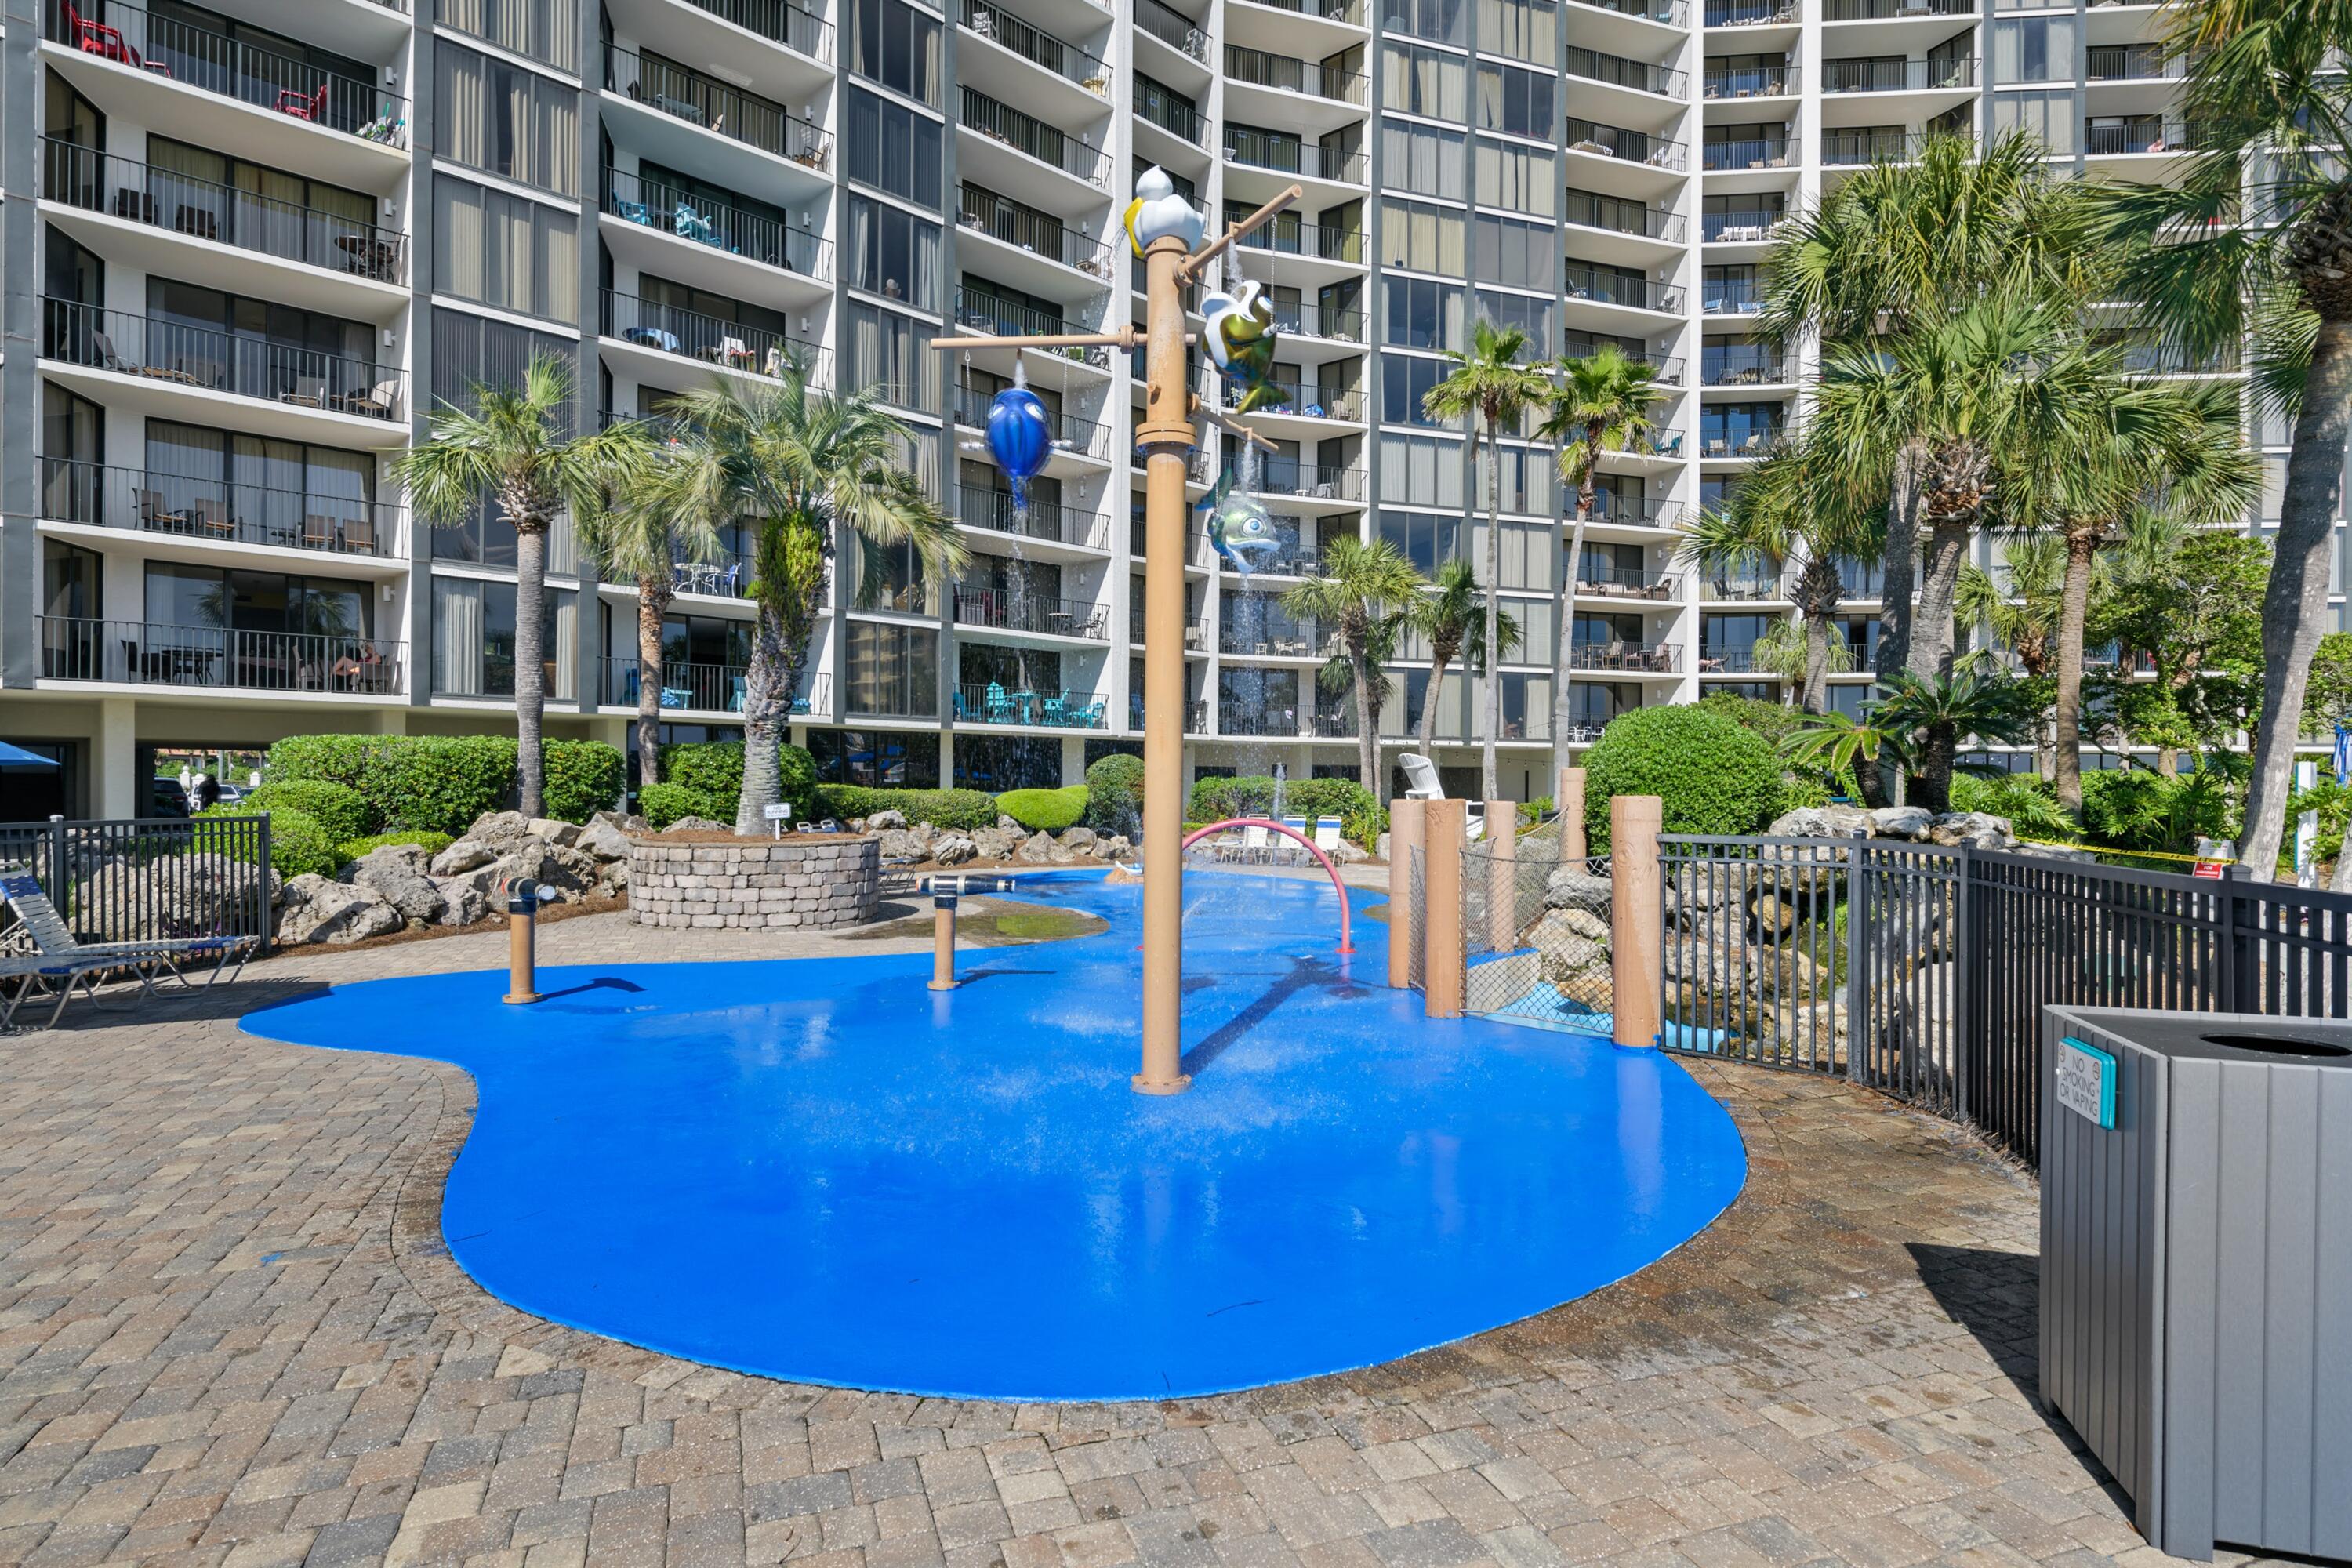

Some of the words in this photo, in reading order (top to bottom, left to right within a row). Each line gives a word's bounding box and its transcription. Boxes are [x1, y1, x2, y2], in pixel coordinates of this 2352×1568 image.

[2072, 1054, 2085, 1073] NO
[2062, 1066, 2096, 1098] SMOKING
[2060, 1082, 2071, 1101] OR
[2071, 1088, 2098, 1116] VAPING
